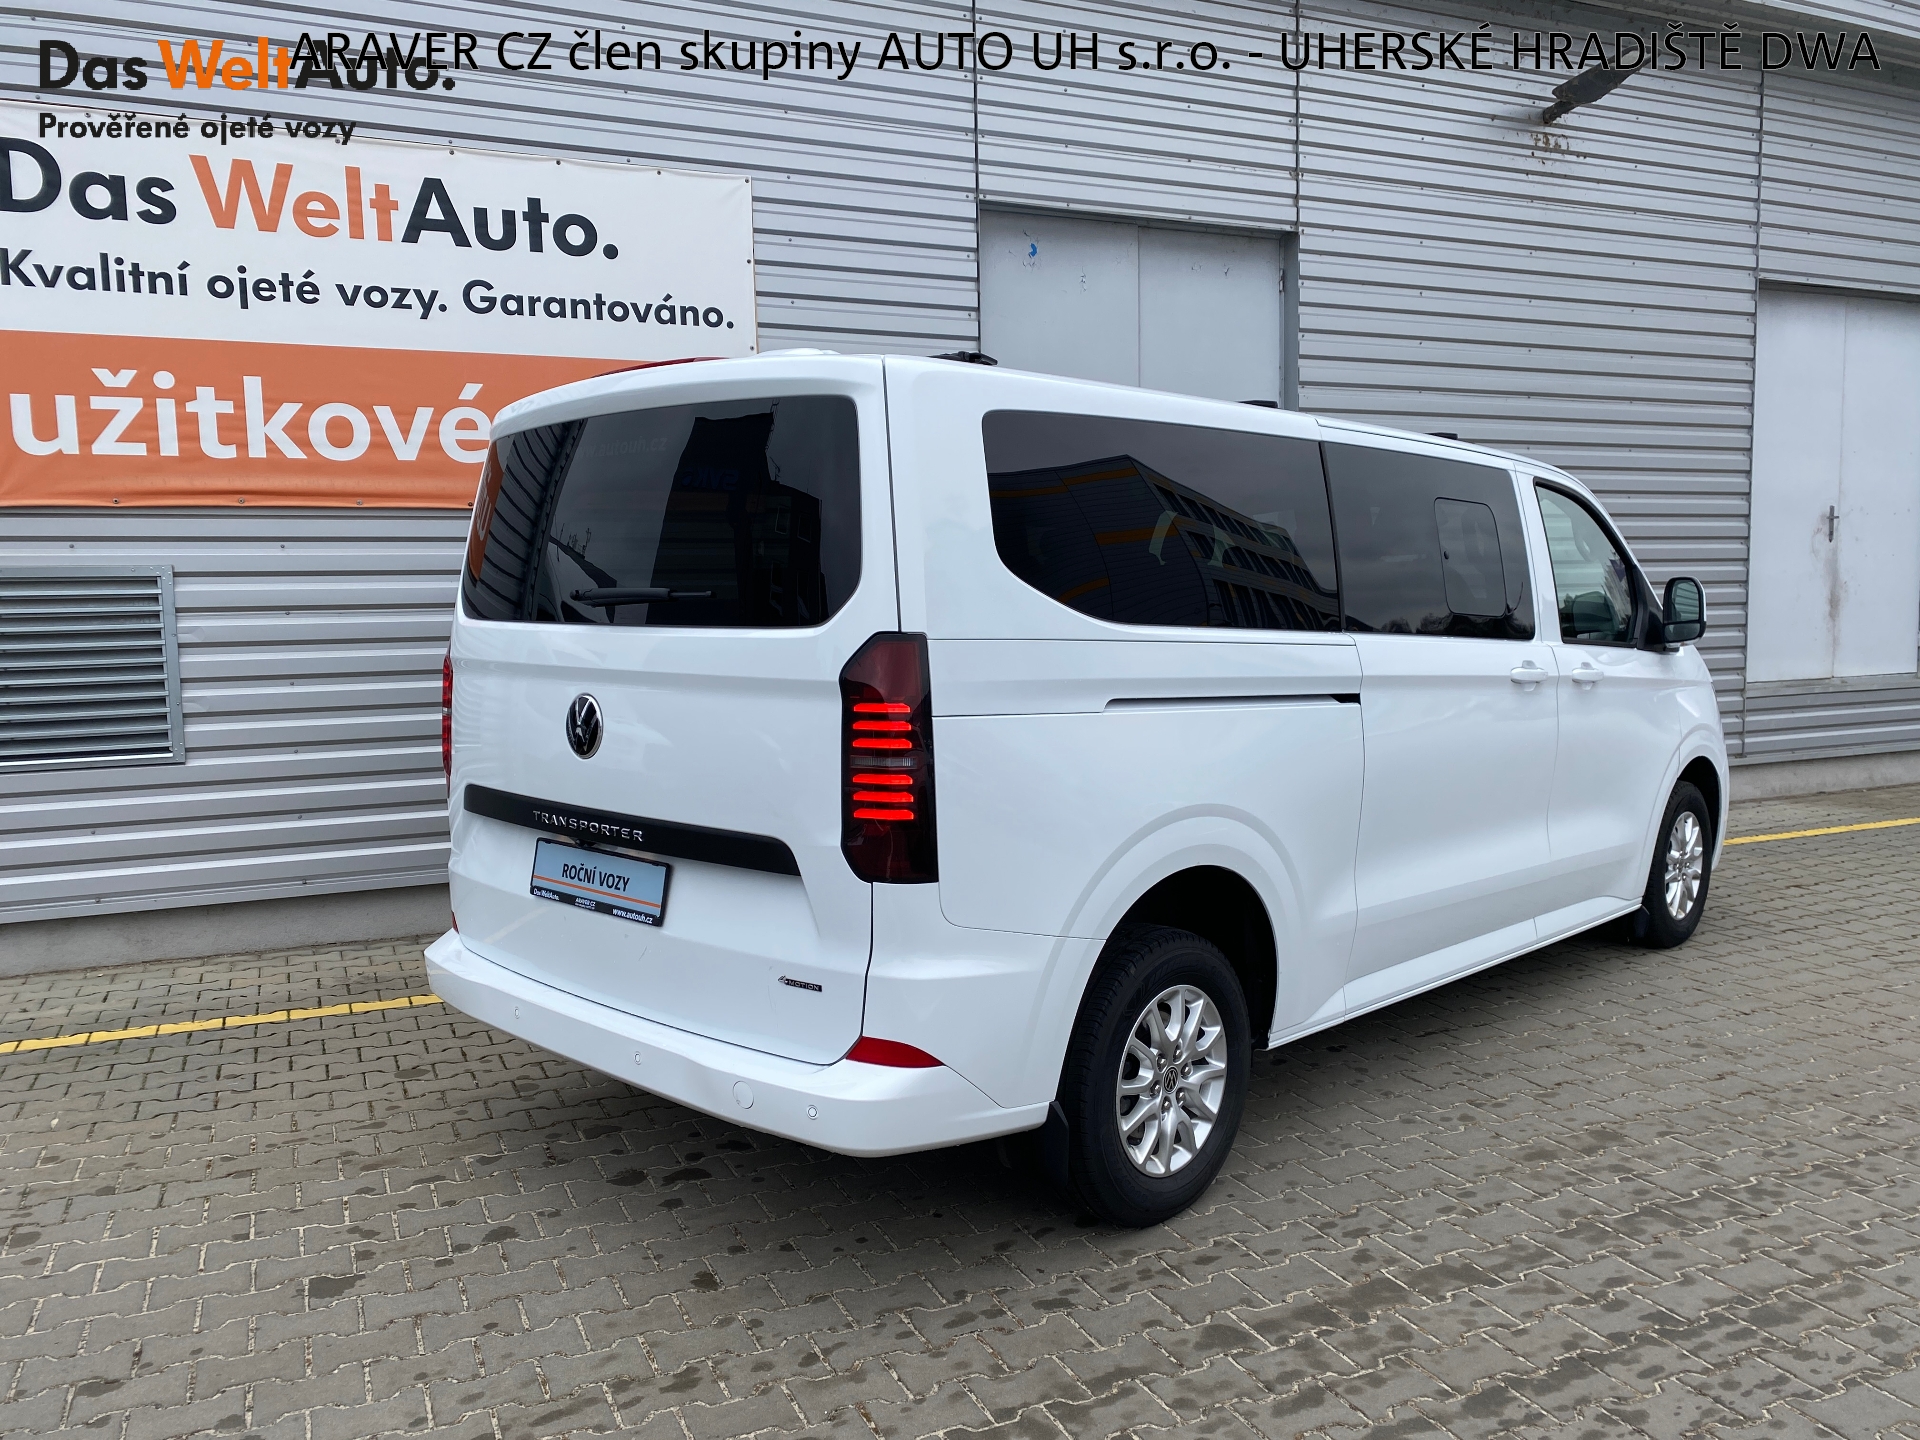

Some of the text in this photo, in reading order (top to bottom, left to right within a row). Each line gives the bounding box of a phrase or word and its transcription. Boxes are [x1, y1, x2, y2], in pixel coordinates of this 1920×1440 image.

[0, 136, 619, 260] Das WeltAuto.
[0, 247, 735, 329] Kvalitní ojeté vozy. Garantováno.
[9, 367, 491, 463] užitkové
[532, 810, 643, 841] TRANSPORTER
[562, 863, 630, 892] ROČNÍ VOZY
[612, 908, 653, 924] www.autouh.cz
